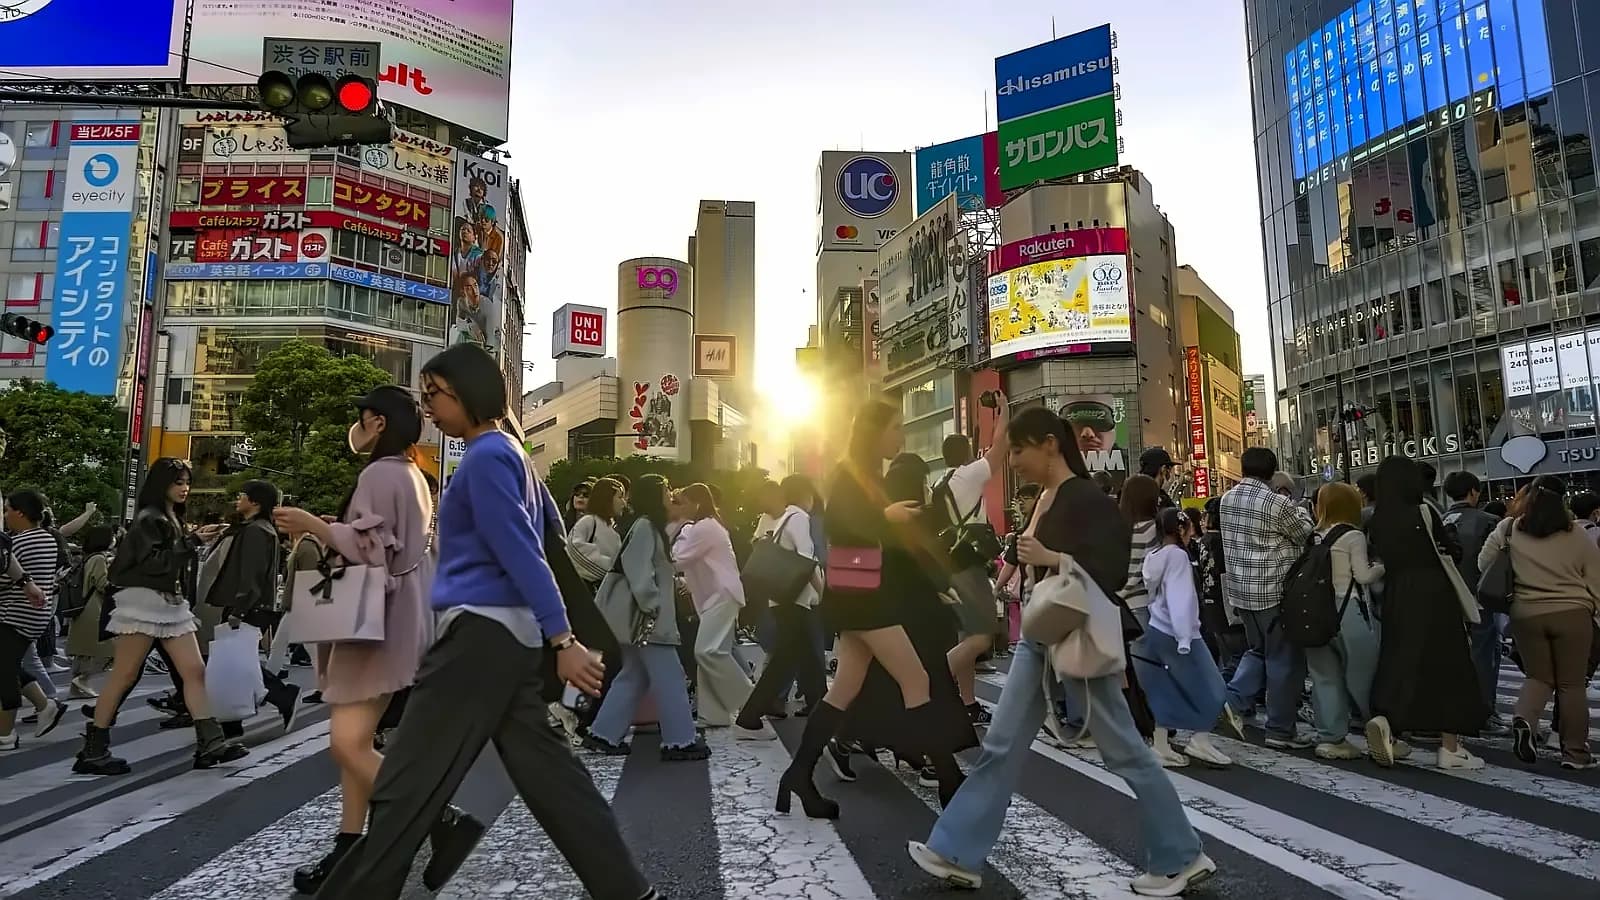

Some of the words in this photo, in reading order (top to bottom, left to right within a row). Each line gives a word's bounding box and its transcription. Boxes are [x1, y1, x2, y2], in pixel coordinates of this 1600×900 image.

[273, 44, 370, 67] 渋谷駅前
[998, 55, 1110, 96] Hisamitsu
[77, 126, 134, 140] 当ビル5F
[182, 138, 203, 151] 9F
[242, 134, 296, 152] しゃぶ
[1005, 117, 1109, 168] サロンパス
[394, 151, 449, 184] しゃぶ葉
[463, 159, 502, 188] Kroi
[930, 153, 971, 180] 龍角散
[72, 189, 126, 204] eyecity
[926, 173, 978, 199] ダイレクト
[203, 180, 303, 199] プライス
[335, 181, 426, 221] コンタクト
[263, 211, 312, 230] ガスト
[171, 240, 196, 255] 7F
[201, 239, 228, 251] Café
[230, 236, 292, 260] ガスト
[400, 231, 441, 255] ガスト
[1019, 237, 1075, 257] Rakuten
[209, 264, 300, 276] 英会話イーオン
[335, 267, 363, 281] AEON
[370, 274, 449, 299] 英会話イーオン
[636, 266, 679, 298] 109
[58, 236, 95, 367] アイシティ
[88, 236, 120, 367] コンタクトの
[575, 316, 597, 328] UNI
[1315, 317, 1346, 336] SAE
[1349, 300, 1395, 324] ONGE
[574, 328, 599, 342] QLO
[705, 348, 726, 362] H&M
[1508, 340, 1573, 359] Tim-baed
[1530, 356, 1554, 366] eats
[1112, 397, 1125, 423] 再び
